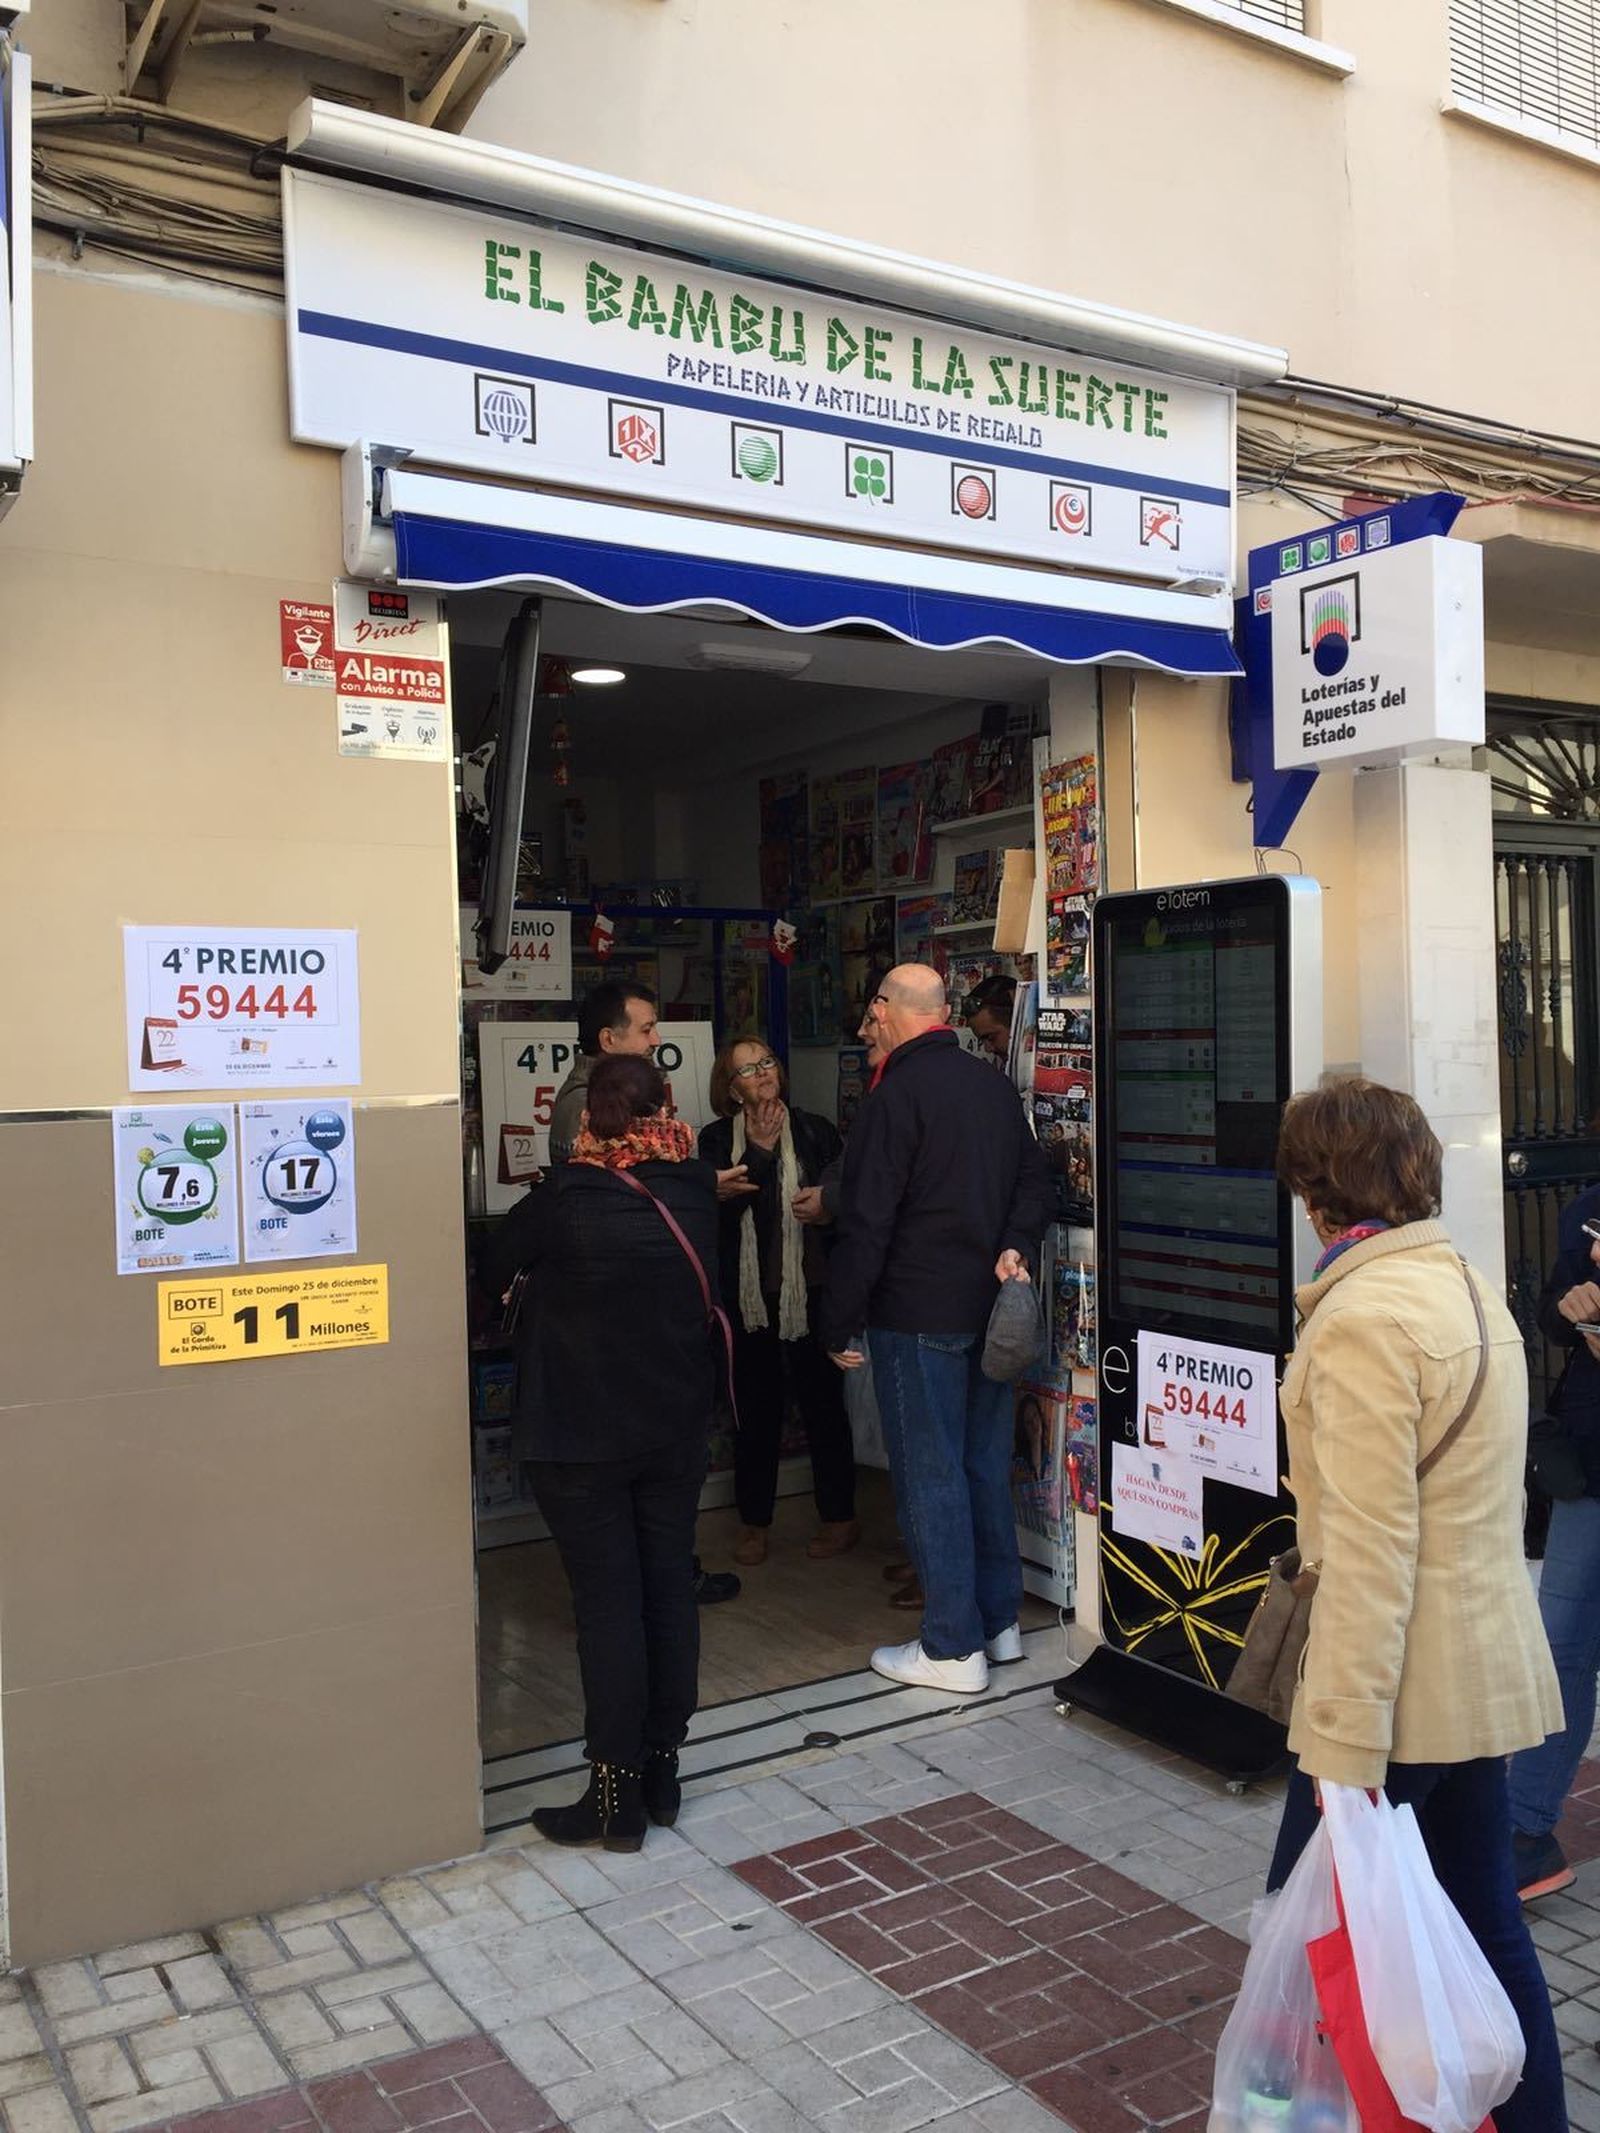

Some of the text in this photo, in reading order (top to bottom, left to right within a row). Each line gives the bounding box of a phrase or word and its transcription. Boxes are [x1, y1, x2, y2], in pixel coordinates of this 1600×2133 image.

[485, 239, 1169, 439] EL BAMBU DE LA SUERTE
[667, 353, 1042, 448] PAPELERIA Y ARTICULOS DE REGALO
[284, 604, 331, 619] Vigilante
[354, 618, 427, 643] Direct
[341, 658, 441, 687] Alarma
[341, 683, 361, 691] con
[364, 682, 395, 695] Aviso
[407, 687, 442, 699] Policía
[1301, 673, 1380, 704] Loterías y
[1303, 687, 1406, 727] Apuestas del
[1302, 724, 1357, 748] Estado
[1156, 889, 1211, 911] eTotem
[511, 921, 555, 937] EMIO
[197, 948, 325, 975] PREMIO
[510, 941, 551, 961] 444
[177, 984, 318, 1020] 59444
[1039, 1019, 1066, 1032] WARS
[1041, 1012, 1066, 1021] STAR
[513, 1139, 534, 1158] 22
[157, 1166, 200, 1201] 7,6
[280, 1158, 320, 1191] 17
[135, 1228, 165, 1241] BOTE
[260, 1217, 288, 1230] BOTE
[232, 1278, 378, 1297] Este Domingo 25 de diciembre
[174, 1297, 217, 1312] BOTE
[191, 1335, 215, 1343] Gordo
[310, 1322, 370, 1337] Millones
[191, 1343, 227, 1352] Primitiva
[1176, 1354, 1253, 1391] PREMIO
[1163, 1382, 1247, 1429] 59444
[1125, 1474, 1187, 1501] HAGAN DESDE
[1138, 1493, 1155, 1506] SUS
[1155, 1497, 1200, 1520] COMPRAS
